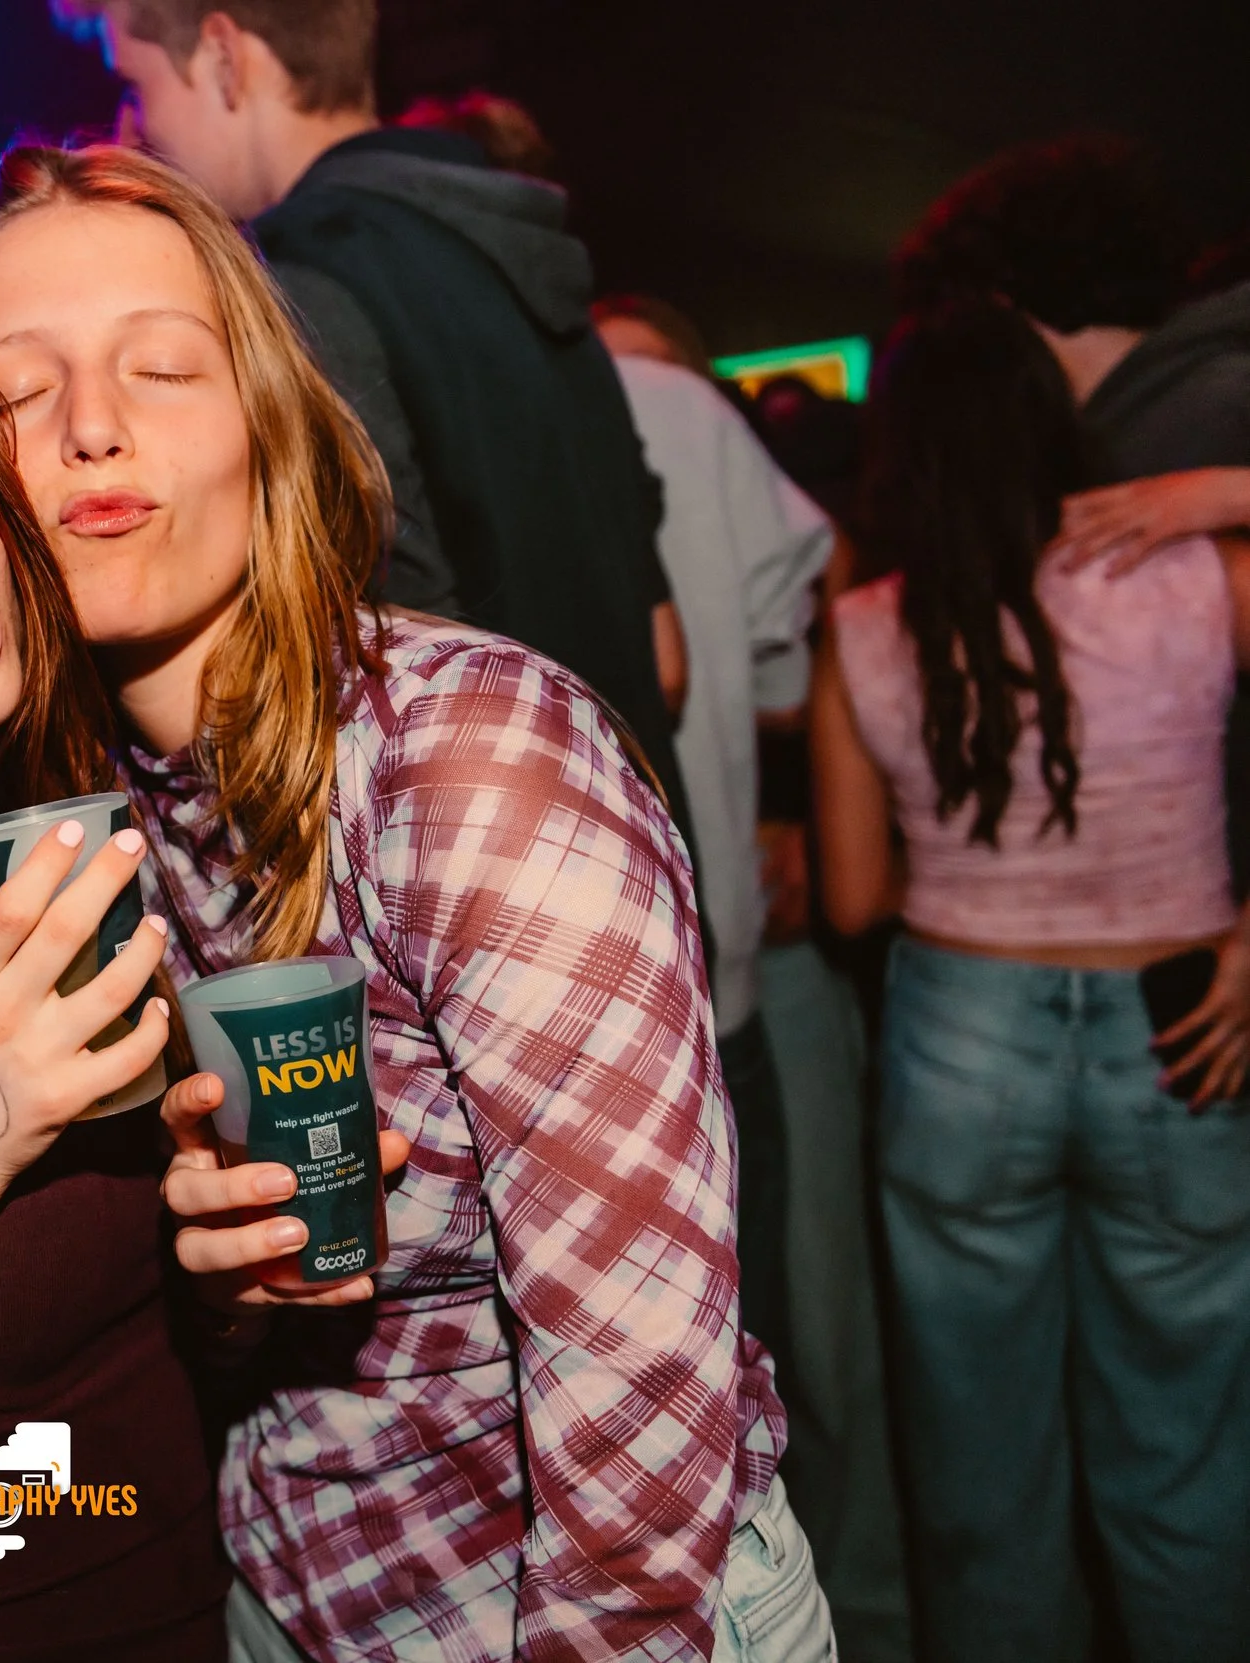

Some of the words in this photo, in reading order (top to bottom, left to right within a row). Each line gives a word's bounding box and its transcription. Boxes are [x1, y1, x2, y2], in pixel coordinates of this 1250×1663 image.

[252, 1025, 327, 1062] LESS
[334, 1015, 356, 1046] IS
[257, 1044, 357, 1096] NOW
[275, 1119, 297, 1129] Help
[300, 1117, 311, 1125] us
[313, 1111, 334, 1124] fight
[335, 1101, 359, 1117] waste!
[296, 1163, 321, 1173] Bring
[322, 1159, 336, 1168] me
[337, 1151, 356, 1164] back
[306, 1174, 322, 1183] can
[323, 1171, 334, 1180] be
[335, 1158, 365, 1177] Re-uzed
[310, 1183, 326, 1194] and
[327, 1180, 345, 1190] over
[347, 1172, 367, 1186] again.
[319, 1236, 359, 1253] re-uz.com
[314, 1248, 367, 1271] ecocup
